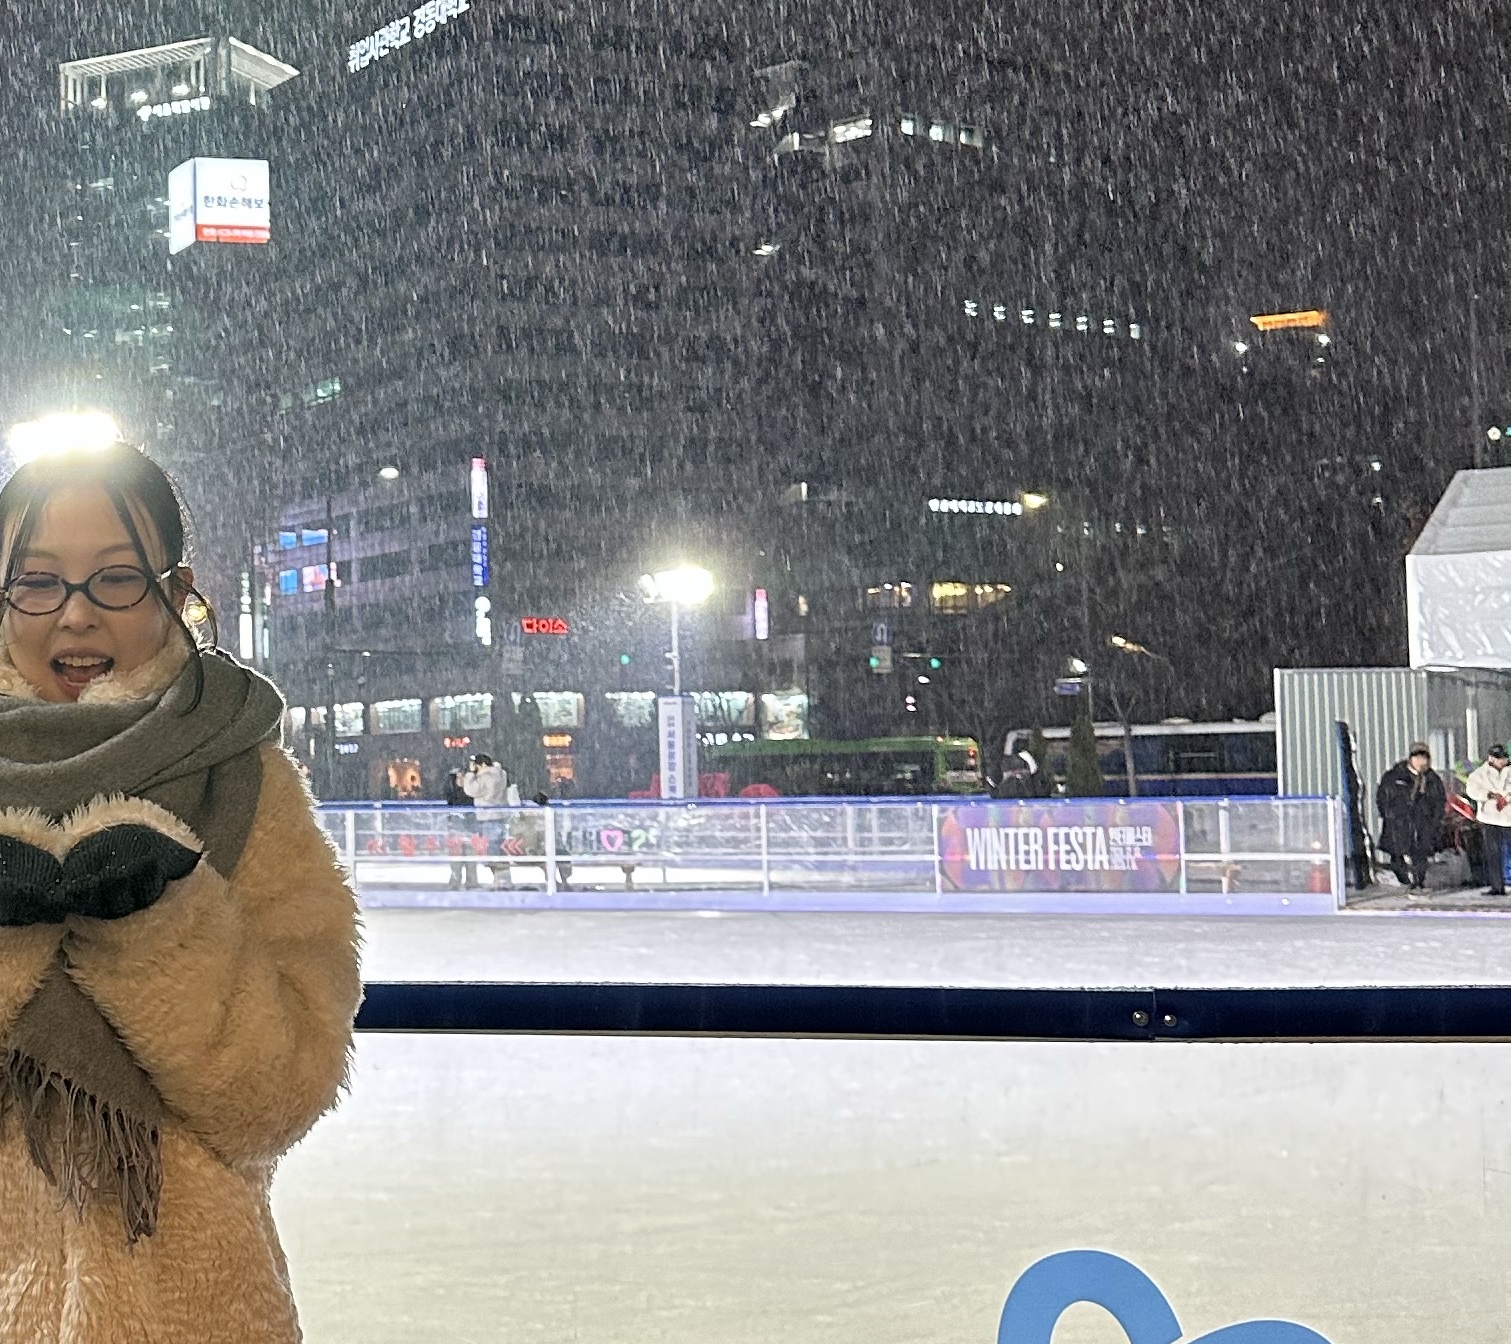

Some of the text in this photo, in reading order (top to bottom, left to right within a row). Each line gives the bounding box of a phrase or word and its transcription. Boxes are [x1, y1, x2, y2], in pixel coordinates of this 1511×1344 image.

[521, 616, 569, 635] 다이소
[966, 827, 1044, 871] WINTER
[1046, 826, 1110, 871] FESTA
